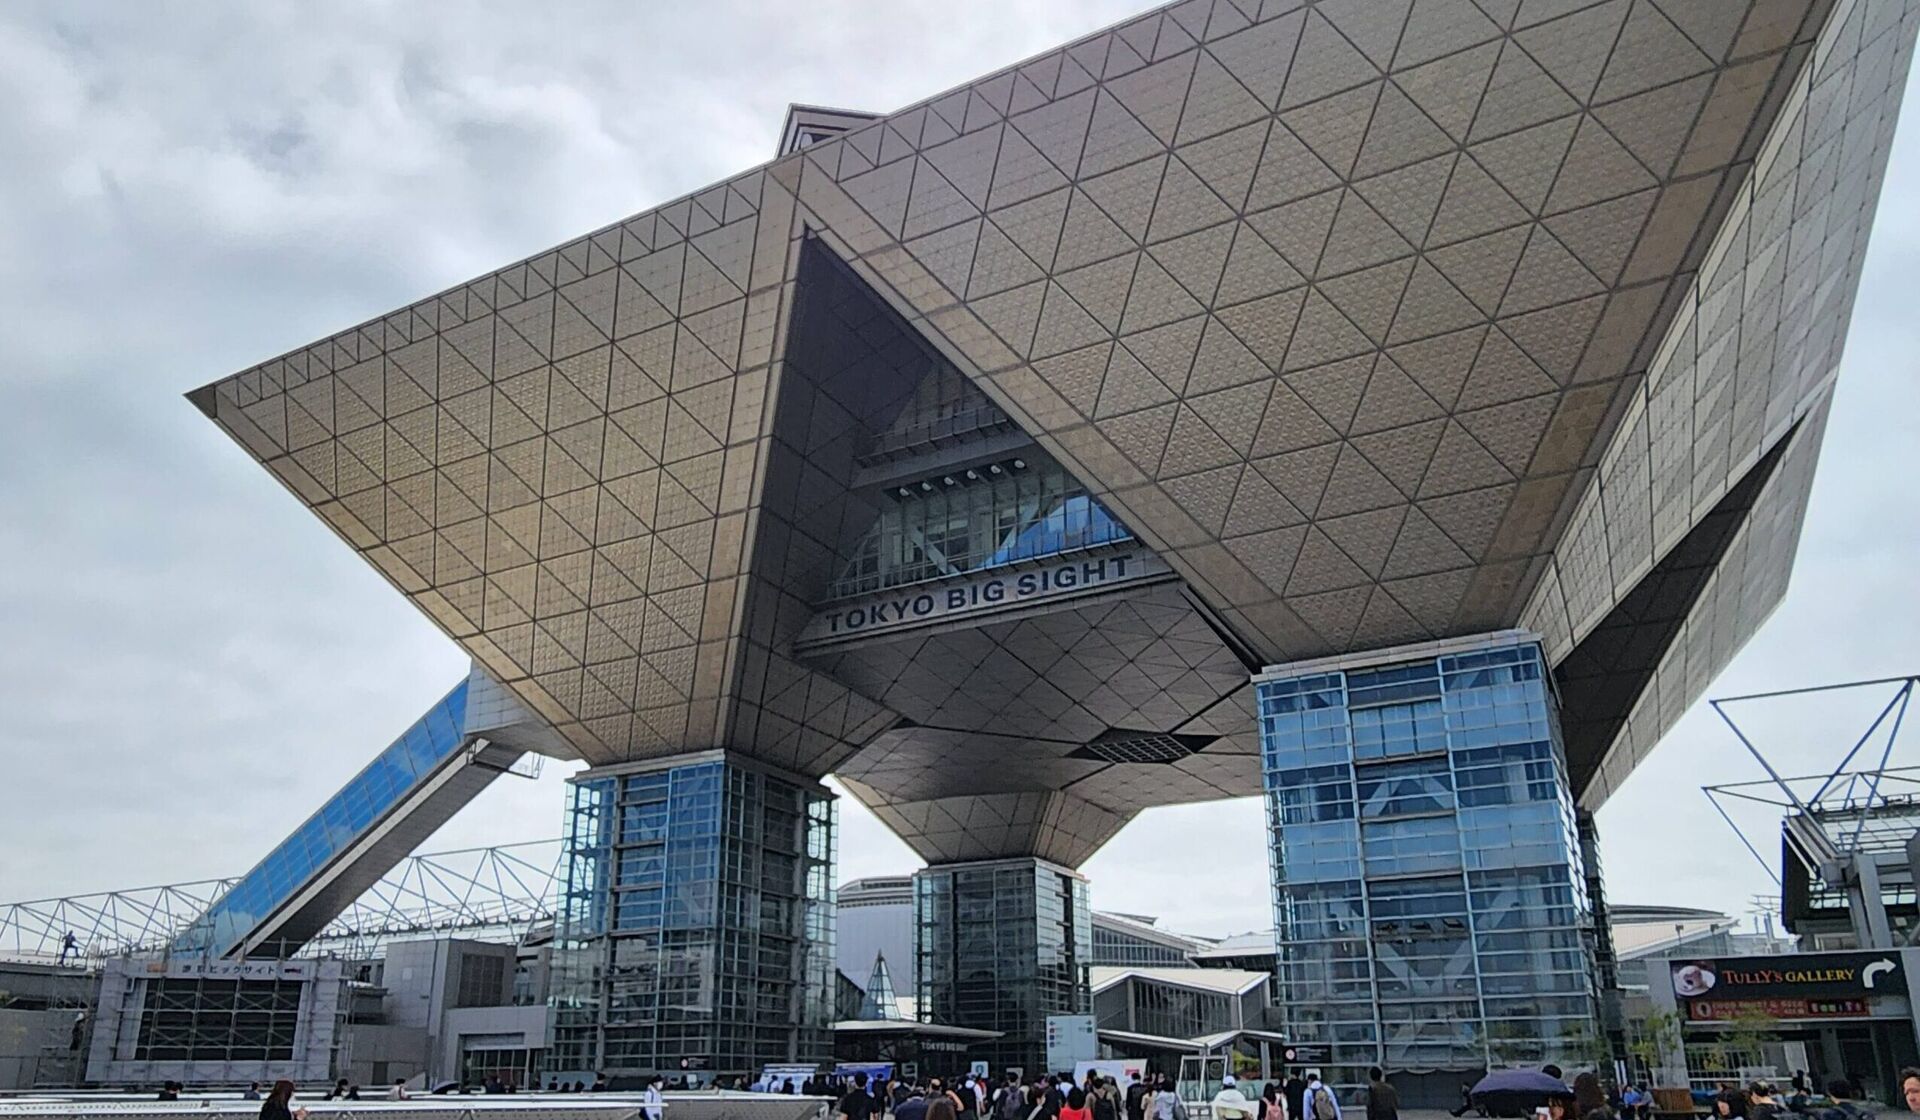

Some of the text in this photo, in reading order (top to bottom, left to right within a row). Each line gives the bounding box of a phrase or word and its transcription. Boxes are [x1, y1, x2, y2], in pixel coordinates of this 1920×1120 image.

[827, 555, 1133, 632] TOKYO BIG SIGHT
[1785, 969, 1855, 983] GALLERY
